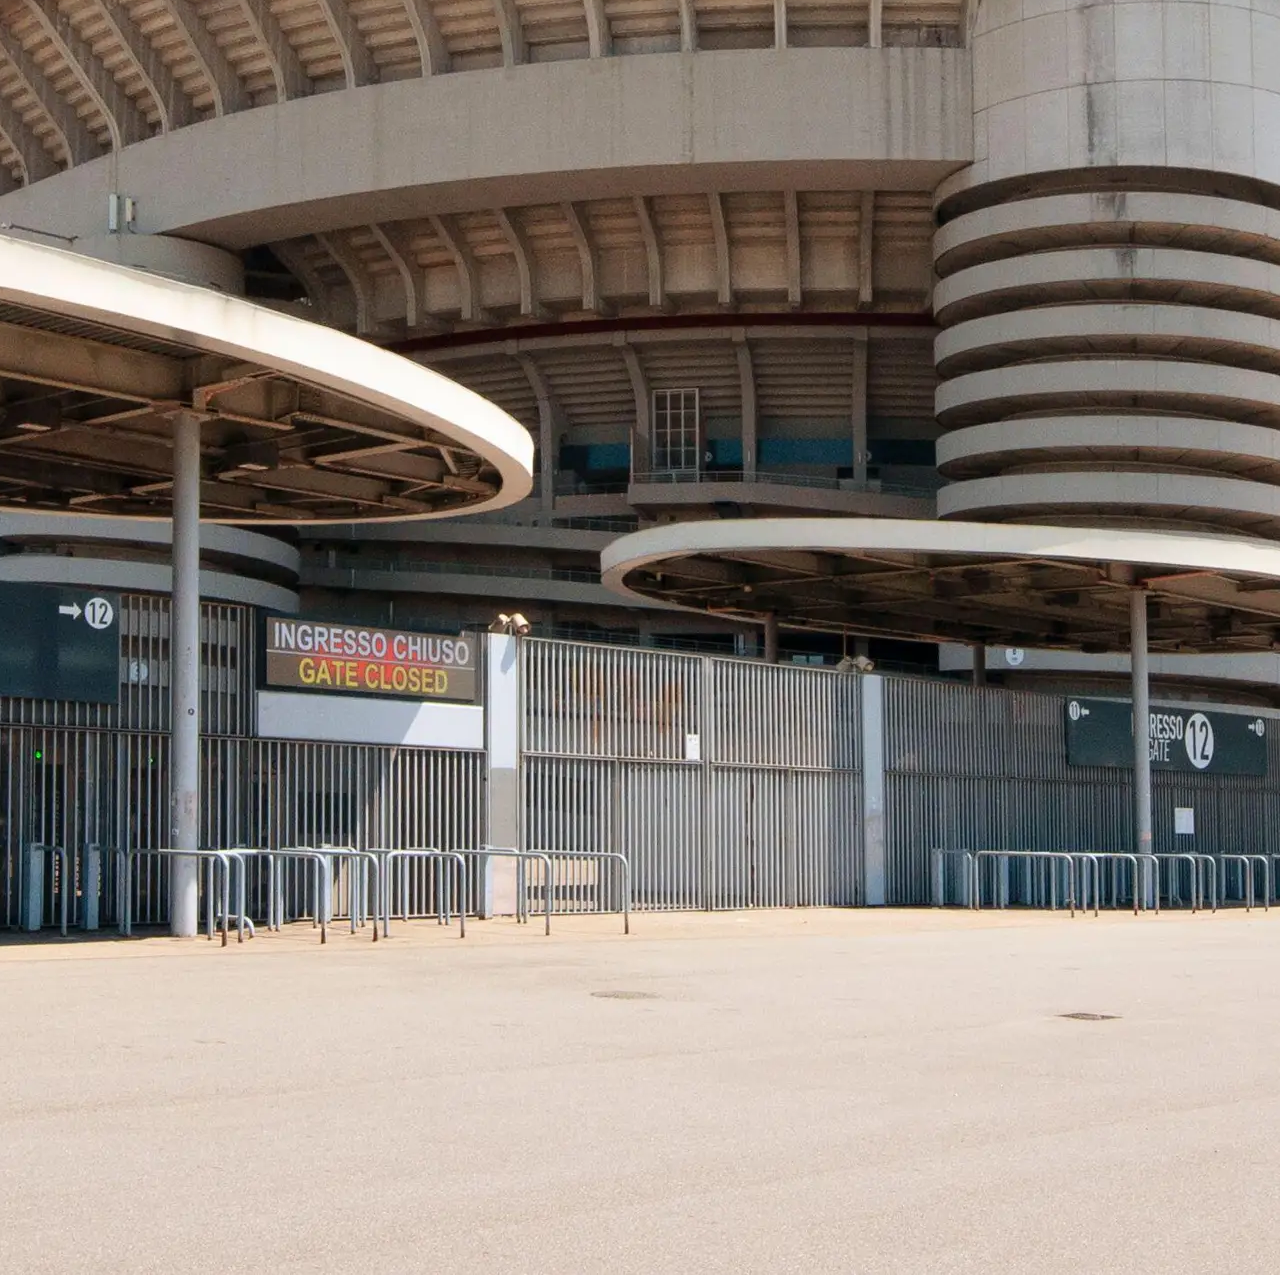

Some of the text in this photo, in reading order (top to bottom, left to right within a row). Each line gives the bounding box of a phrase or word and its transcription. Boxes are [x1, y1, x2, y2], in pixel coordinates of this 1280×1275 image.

[89, 601, 108, 625] 12
[274, 622, 469, 665] INGRESSO CHIUSO
[299, 657, 448, 694] GATE CLOSED
[1071, 703, 1078, 718] 11
[1189, 720, 1210, 761] 12
